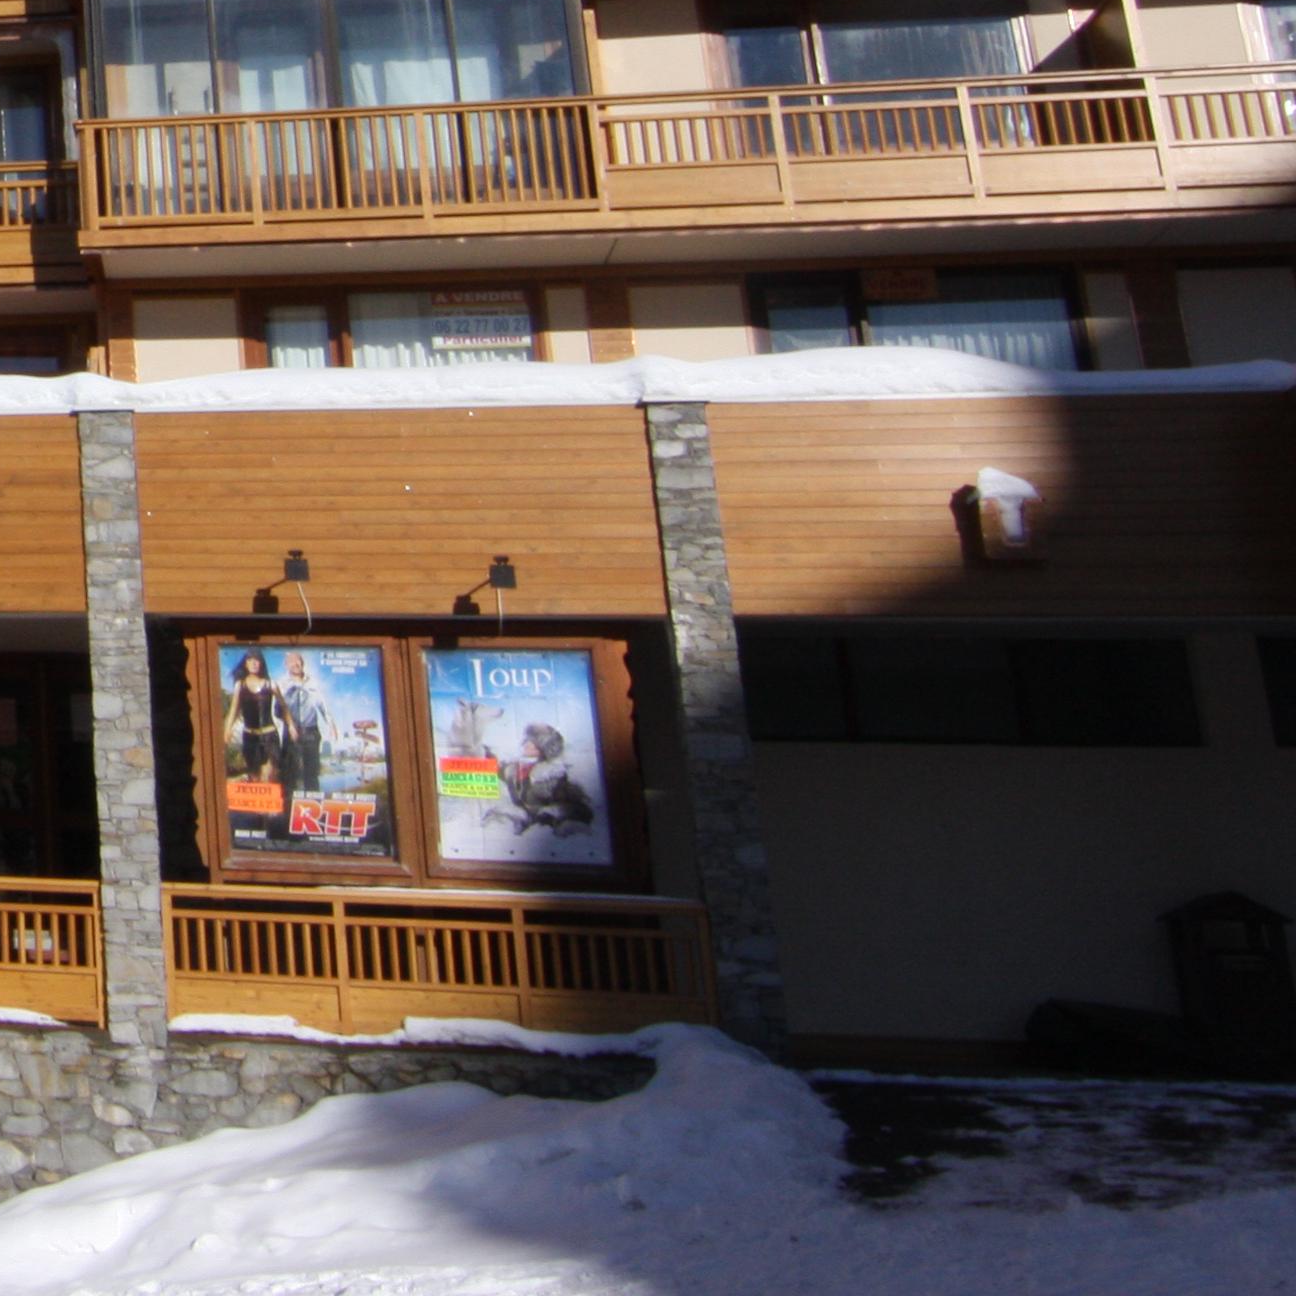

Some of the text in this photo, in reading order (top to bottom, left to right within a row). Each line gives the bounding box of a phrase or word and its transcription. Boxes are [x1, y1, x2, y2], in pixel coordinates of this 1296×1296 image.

[435, 290, 524, 303] A VENDRE
[455, 319, 470, 334] 22
[474, 318, 488, 333] 77
[471, 657, 552, 699] Loup
[235, 784, 272, 795] JEUDI
[290, 799, 375, 836] RTT
